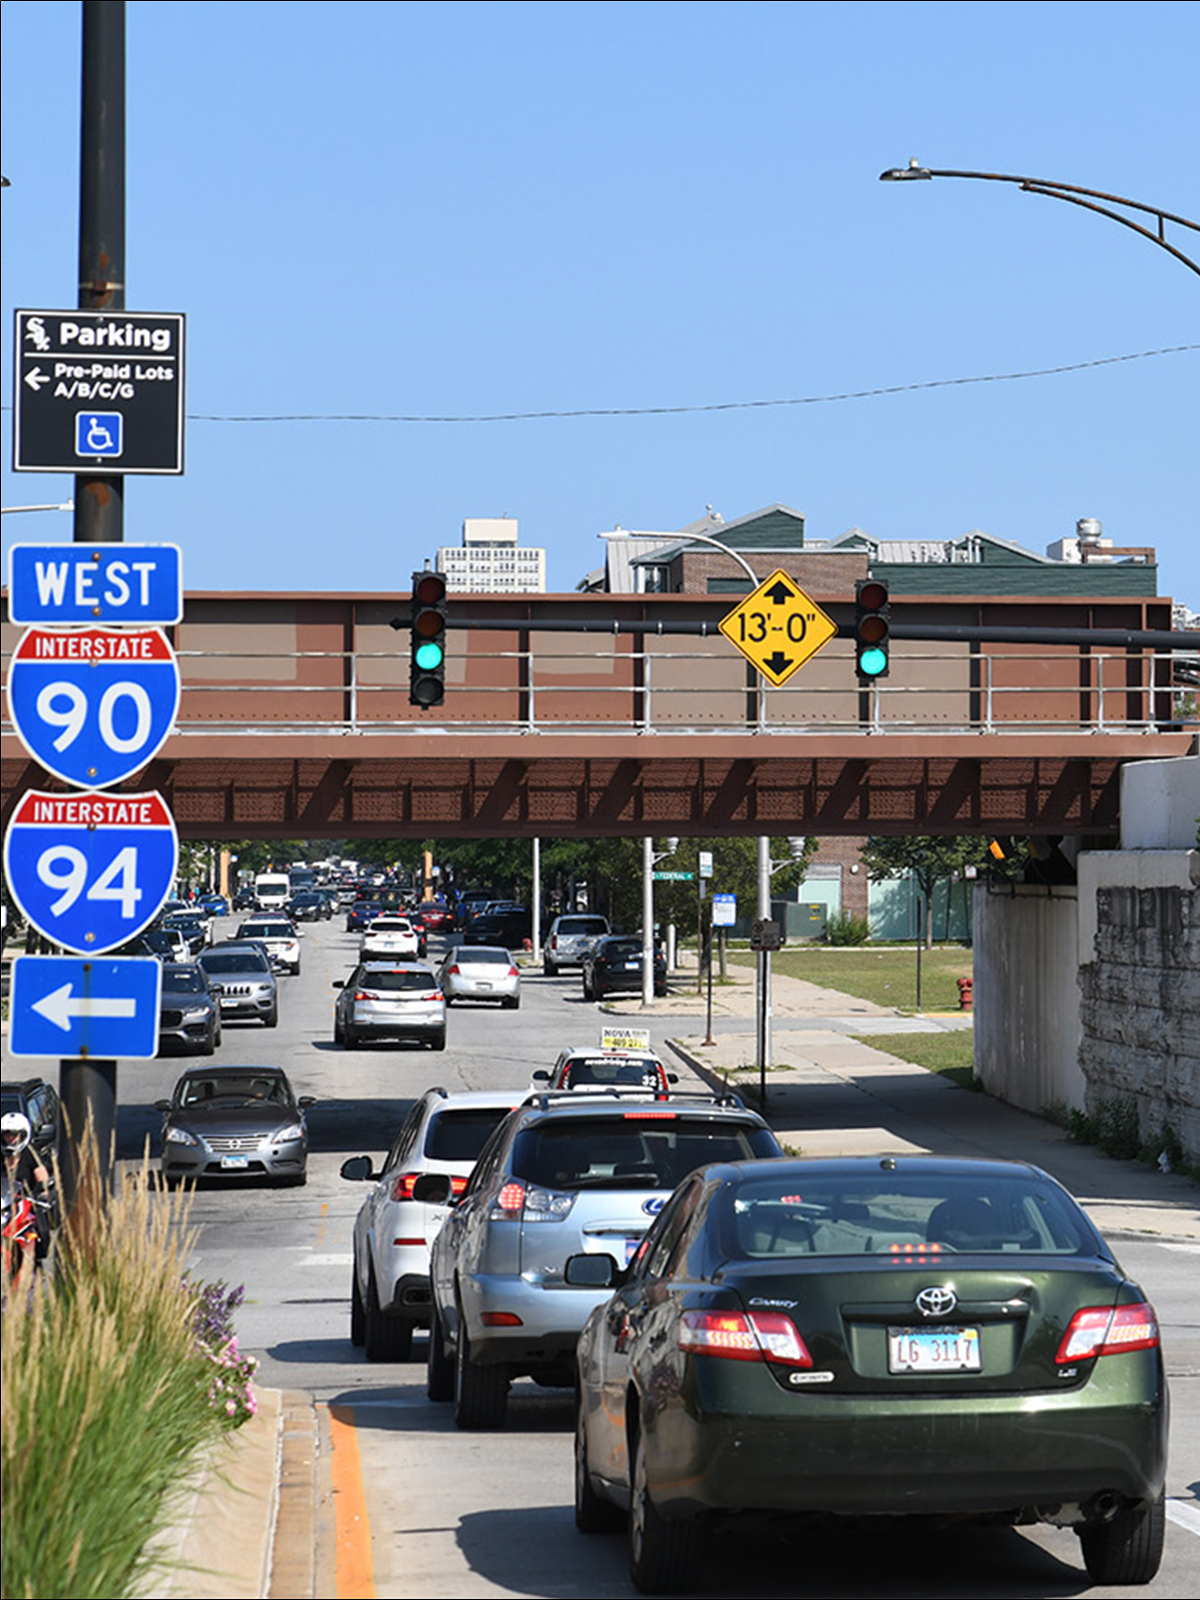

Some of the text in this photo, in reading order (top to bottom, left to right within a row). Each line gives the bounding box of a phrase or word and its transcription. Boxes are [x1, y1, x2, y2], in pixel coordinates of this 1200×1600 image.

[60, 322, 171, 351] Parking
[54, 363, 174, 380] Pre-Paid Lots
[54, 381, 135, 400] A/B/C/G
[35, 562, 156, 606] WEST
[35, 637, 153, 658] INTERSTATE
[36, 681, 151, 754] 90
[33, 802, 152, 823] INTERSTATE
[36, 845, 142, 919] 94
[604, 1029, 631, 1037] NOVA
[642, 1075, 657, 1087] 32
[898, 1339, 972, 1363] LG 3117
